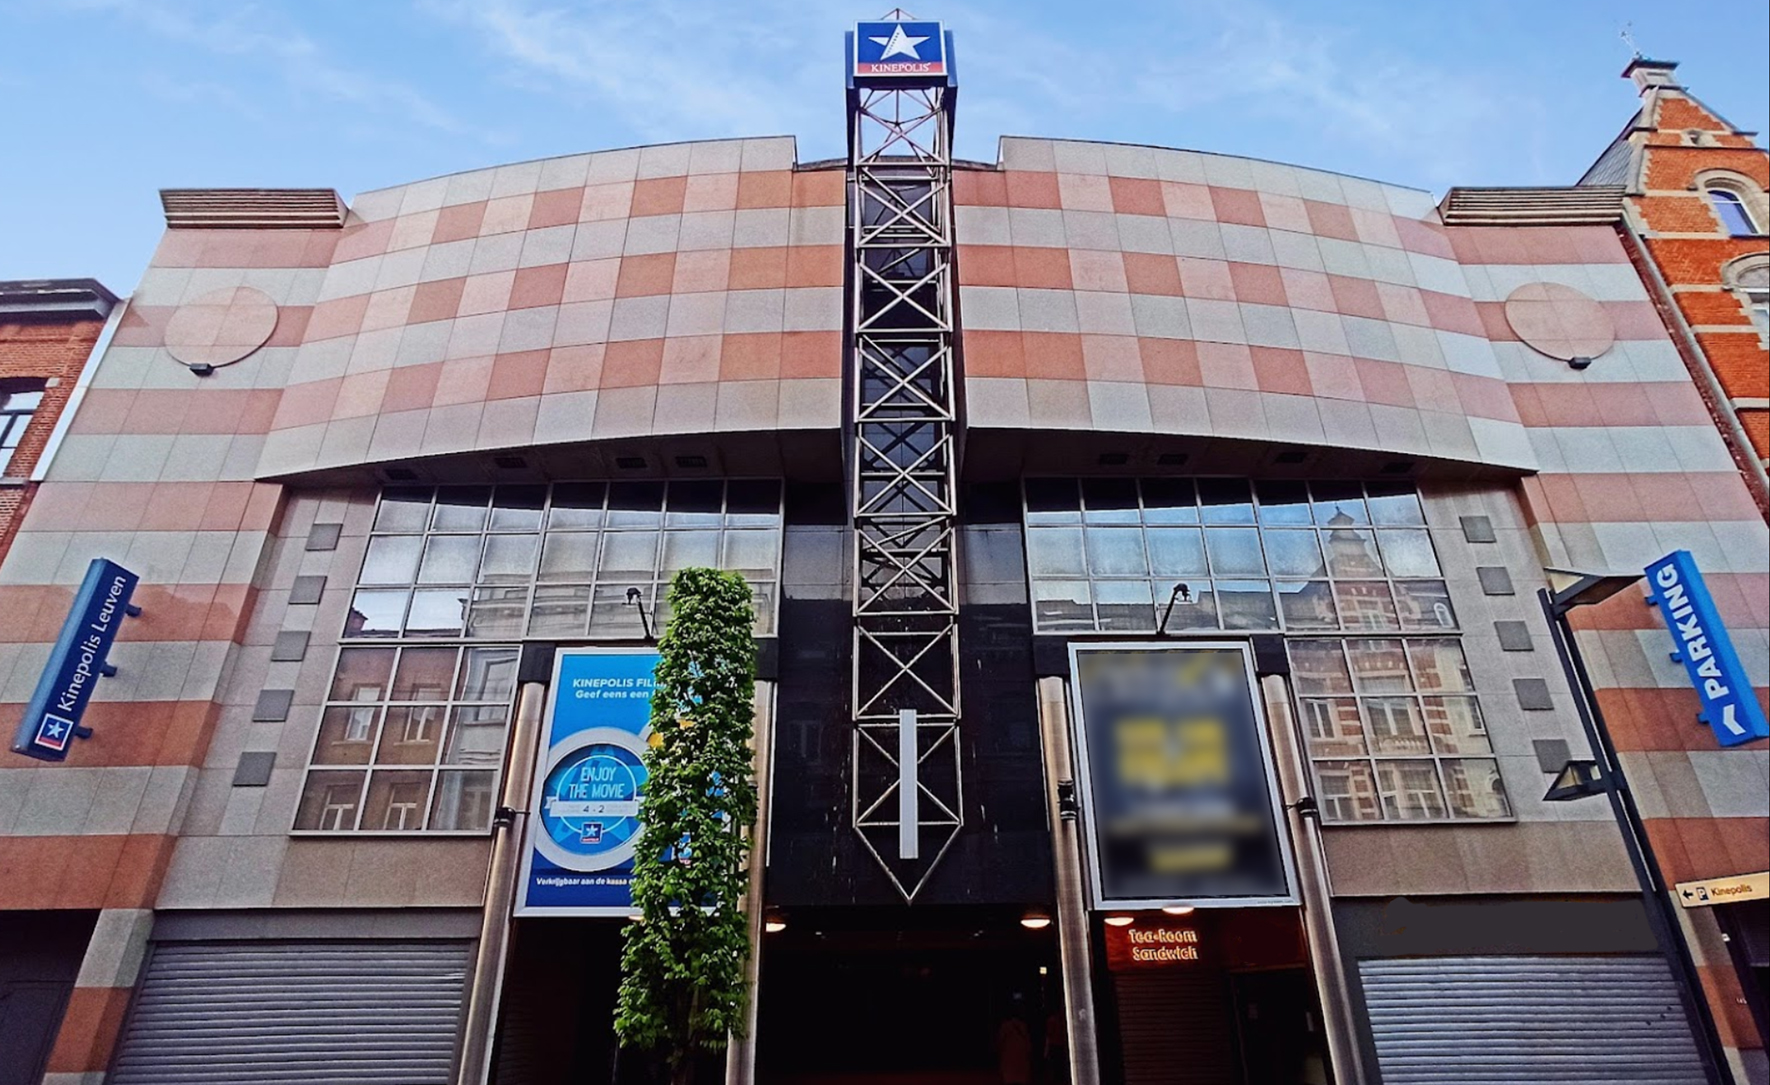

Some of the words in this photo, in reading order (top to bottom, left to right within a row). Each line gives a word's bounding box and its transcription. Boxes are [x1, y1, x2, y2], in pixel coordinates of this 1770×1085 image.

[871, 62, 931, 73] KINEPOLIS
[1656, 563, 1730, 701] PARKING
[57, 634, 101, 712] Kinepolis
[91, 576, 127, 632] Leuven
[573, 678, 633, 688] KINEPOLIS
[575, 690, 601, 699] Geef
[602, 691, 627, 699] eens
[629, 691, 649, 699] een
[580, 767, 617, 782] ENJOY
[569, 783, 589, 799] THE
[591, 783, 625, 799] MOVIE
[595, 877, 606, 885] de
[1710, 884, 1753, 896] Kinepolis
[1128, 928, 1198, 944] Tea-Room
[1132, 945, 1199, 961] Sandwich
